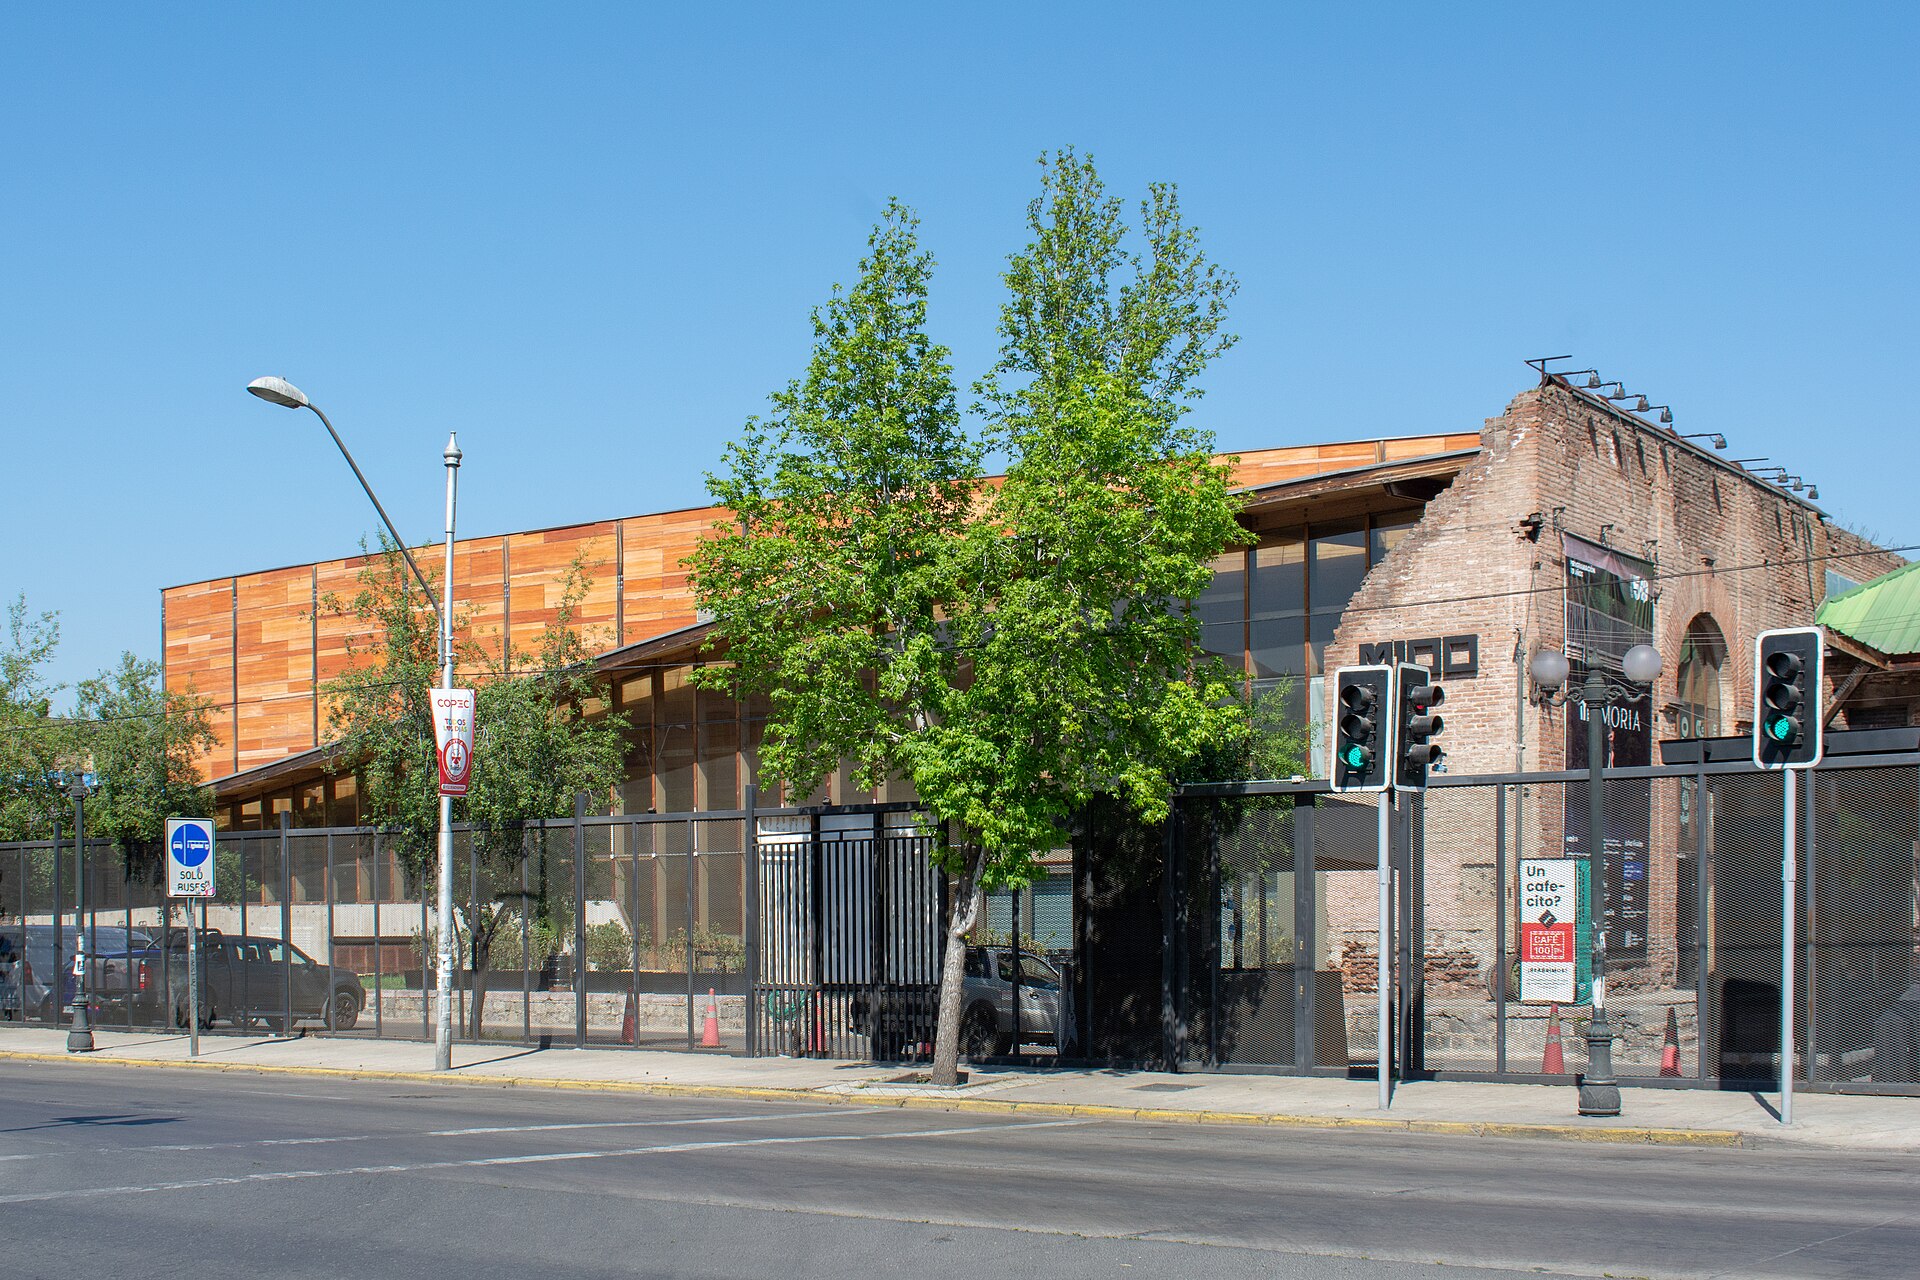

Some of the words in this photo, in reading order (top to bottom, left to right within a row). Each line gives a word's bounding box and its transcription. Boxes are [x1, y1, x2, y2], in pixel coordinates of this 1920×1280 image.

[437, 698, 470, 709] COPEC
[444, 717, 467, 726] TODOS
[180, 871, 203, 880] SOLO
[1527, 865, 1546, 877] Un
[177, 882, 206, 892] BUSES
[1526, 880, 1566, 892] cafe-
[1526, 895, 1561, 907] cito?
[1534, 946, 1551, 955] 100
